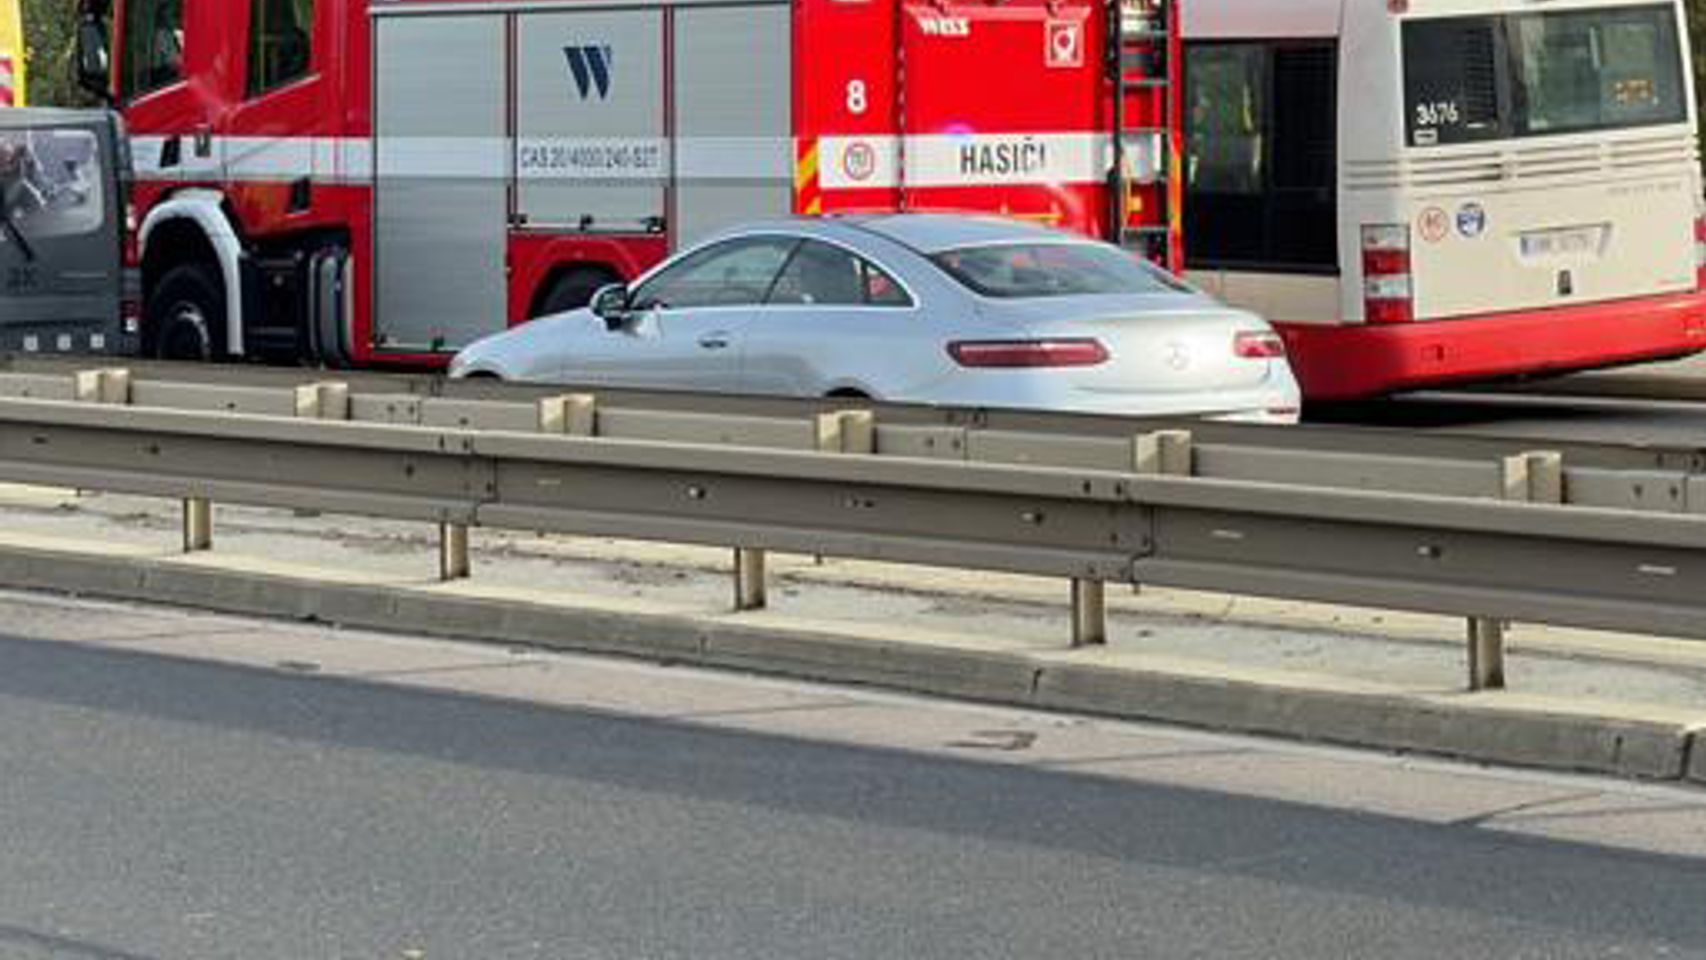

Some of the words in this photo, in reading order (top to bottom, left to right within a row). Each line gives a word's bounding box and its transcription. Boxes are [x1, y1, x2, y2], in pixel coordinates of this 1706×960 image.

[846, 79, 867, 114] 8
[1416, 101, 1459, 125] 3676
[960, 137, 1046, 175] HASIČI
